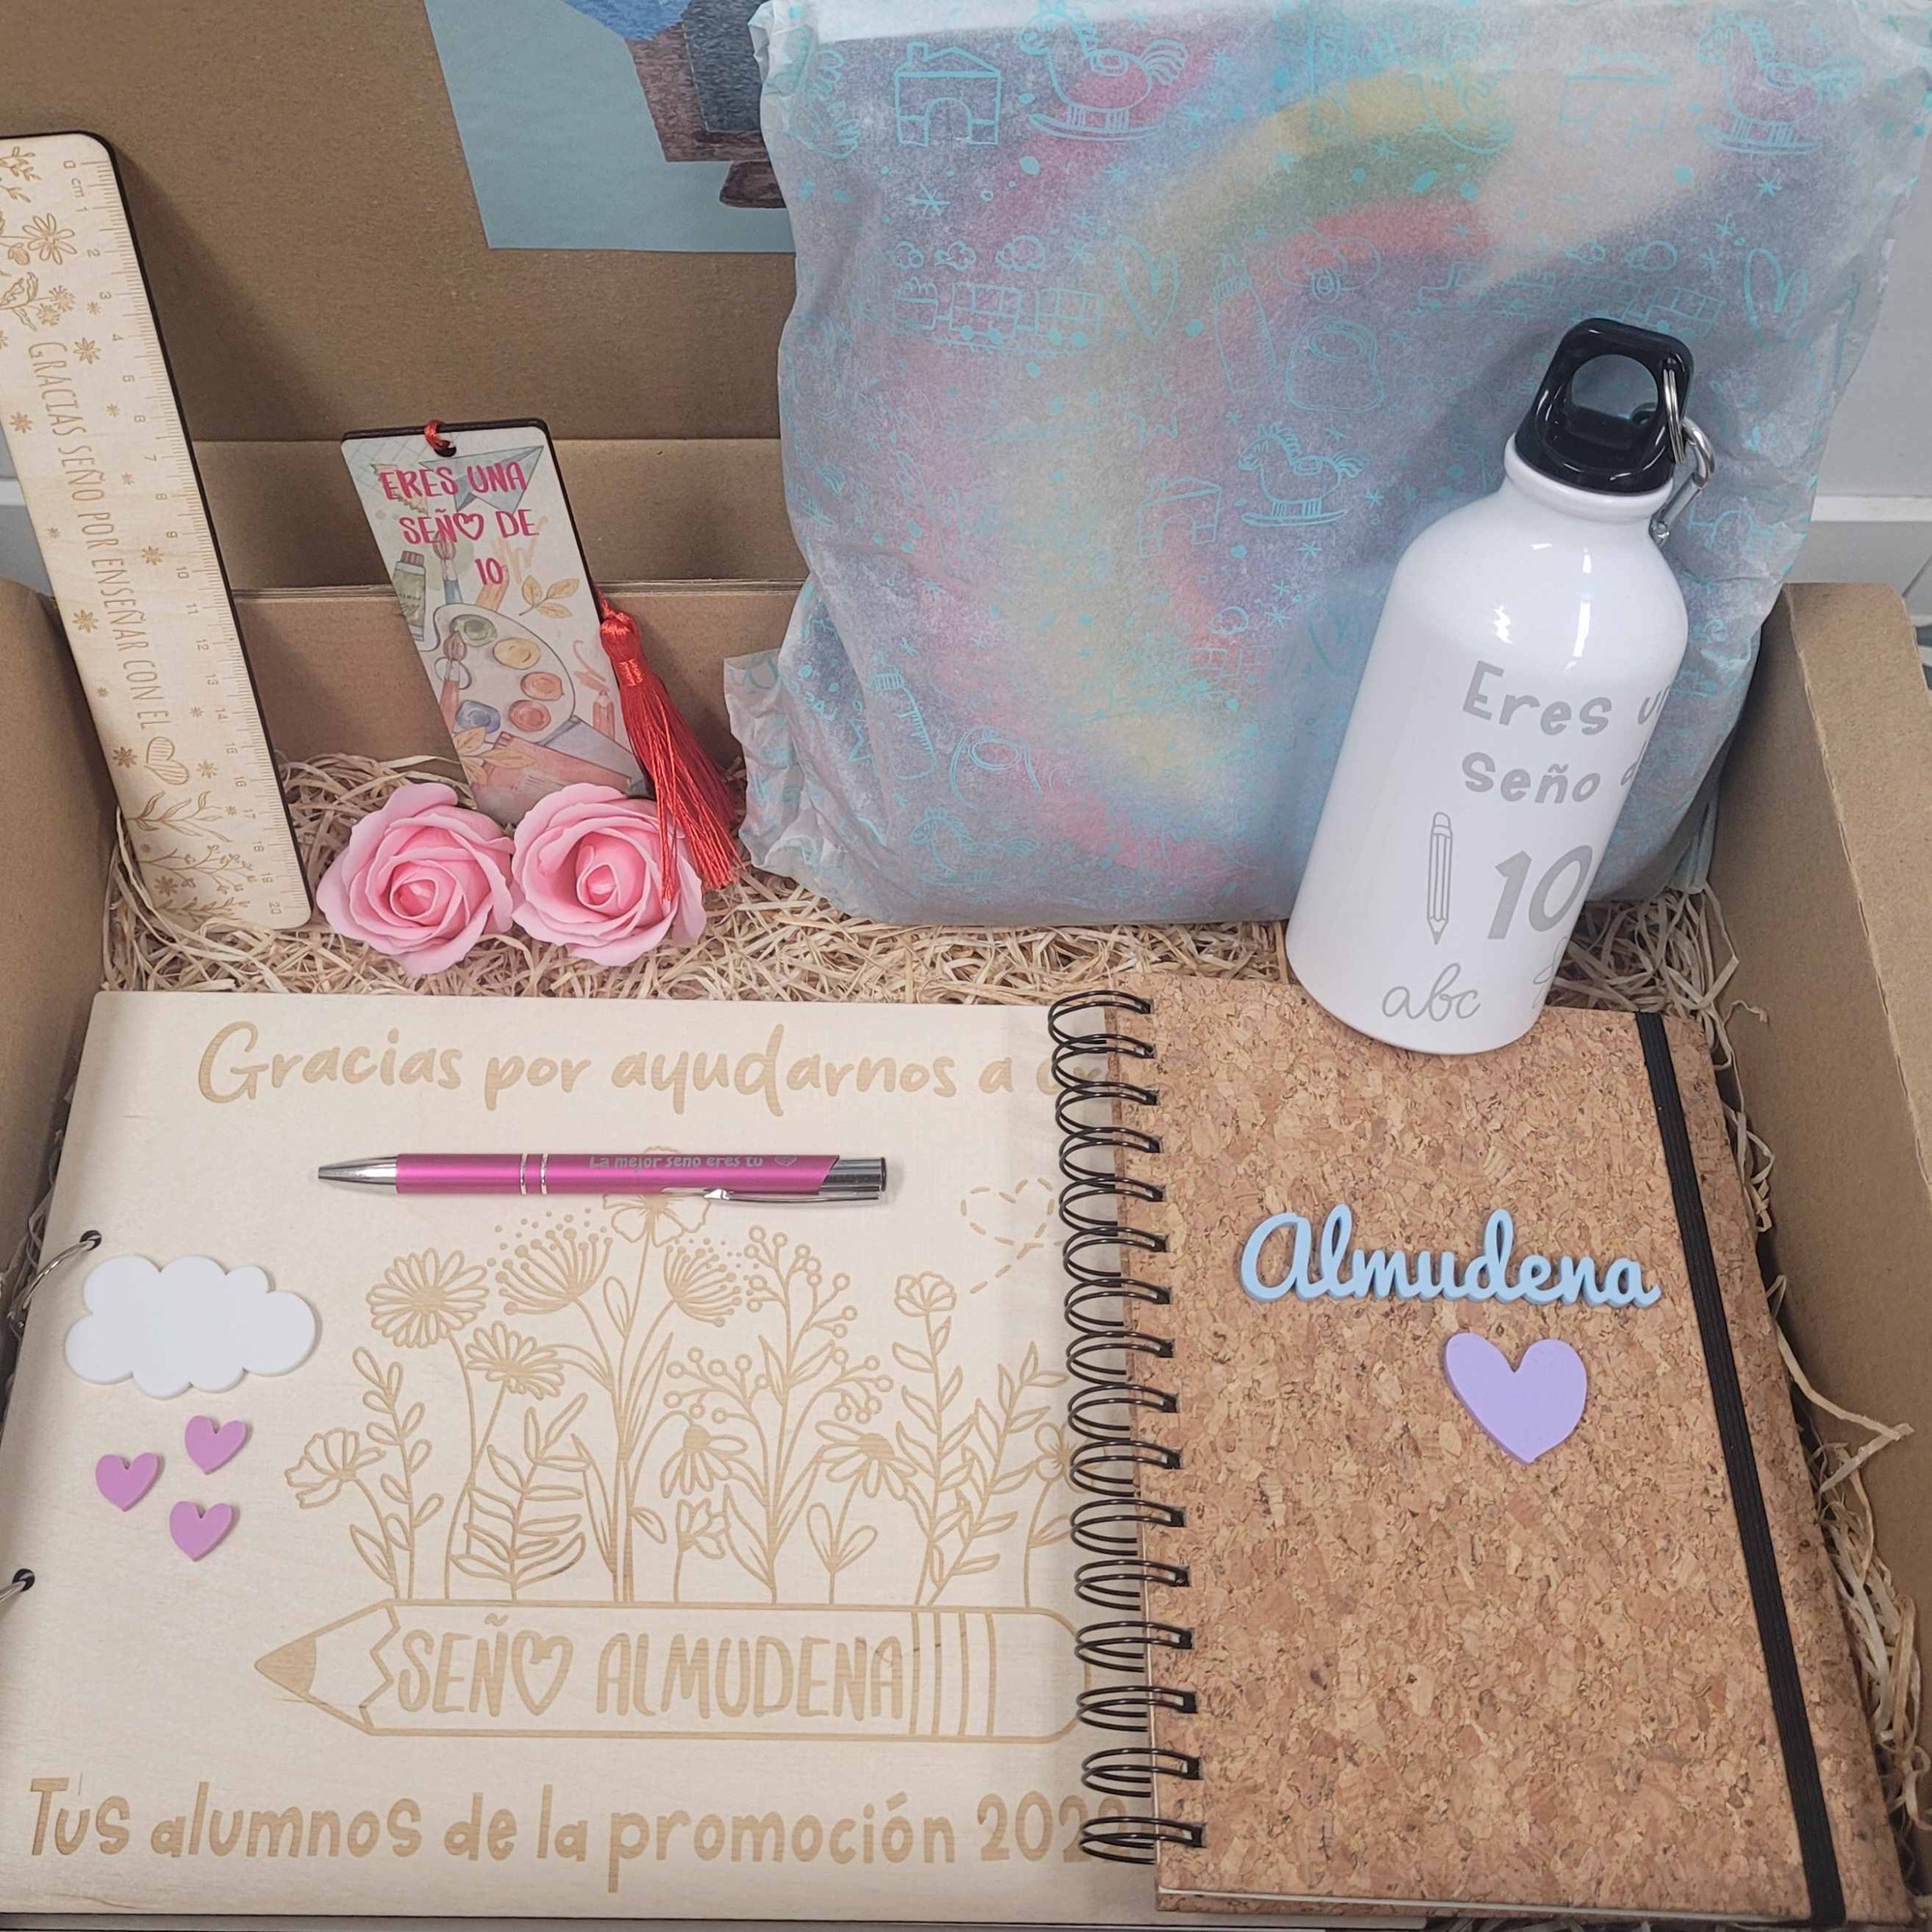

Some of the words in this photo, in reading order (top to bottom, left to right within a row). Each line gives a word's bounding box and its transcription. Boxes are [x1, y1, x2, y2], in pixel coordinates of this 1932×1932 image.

[28, 342, 87, 436] GRACIAS
[57, 445, 106, 501] SEÑO
[380, 466, 459, 500] ERES
[466, 461, 528, 494] UNA
[63, 160, 76, 169] 0
[71, 177, 85, 198] cm
[87, 248, 100, 257] 2
[100, 291, 112, 300] 3
[112, 334, 124, 342] 4
[166, 531, 178, 539] 9
[176, 566, 189, 580] 10
[186, 603, 198, 614] 11
[196, 638, 209, 651] 12
[205, 673, 220, 686] 13
[242, 808, 257, 820] 17
[261, 872, 274, 883] 19
[269, 902, 282, 915] 20
[76, 512, 119, 550] POR
[497, 509, 540, 538] DE
[475, 558, 505, 586] 10
[91, 558, 149, 652] ENSEÑAR
[123, 659, 165, 701] CON
[1461, 660, 1614, 736] Eres
[137, 710, 171, 730] EL
[1461, 752, 1601, 804] Seño
[1487, 844, 1593, 940] 10
[1382, 962, 1481, 1021] abc
[198, 1020, 463, 1104] Gracias
[485, 1055, 592, 1111] por
[611, 1023, 957, 1117] ayudarnos
[980, 1056, 1014, 1094] a
[589, 1156, 609, 1168] La
[614, 1156, 662, 1177] mejor
[706, 1155, 740, 1168] eres
[1241, 1204, 1662, 1309] Almudena
[596, 1632, 903, 1721] ALMUDENA
[30, 1777, 131, 1856] Tus
[151, 1782, 423, 1858] alumnos
[445, 1792, 518, 1861] de
[537, 1784, 587, 1862] la
[608, 1791, 956, 1894] promoción
